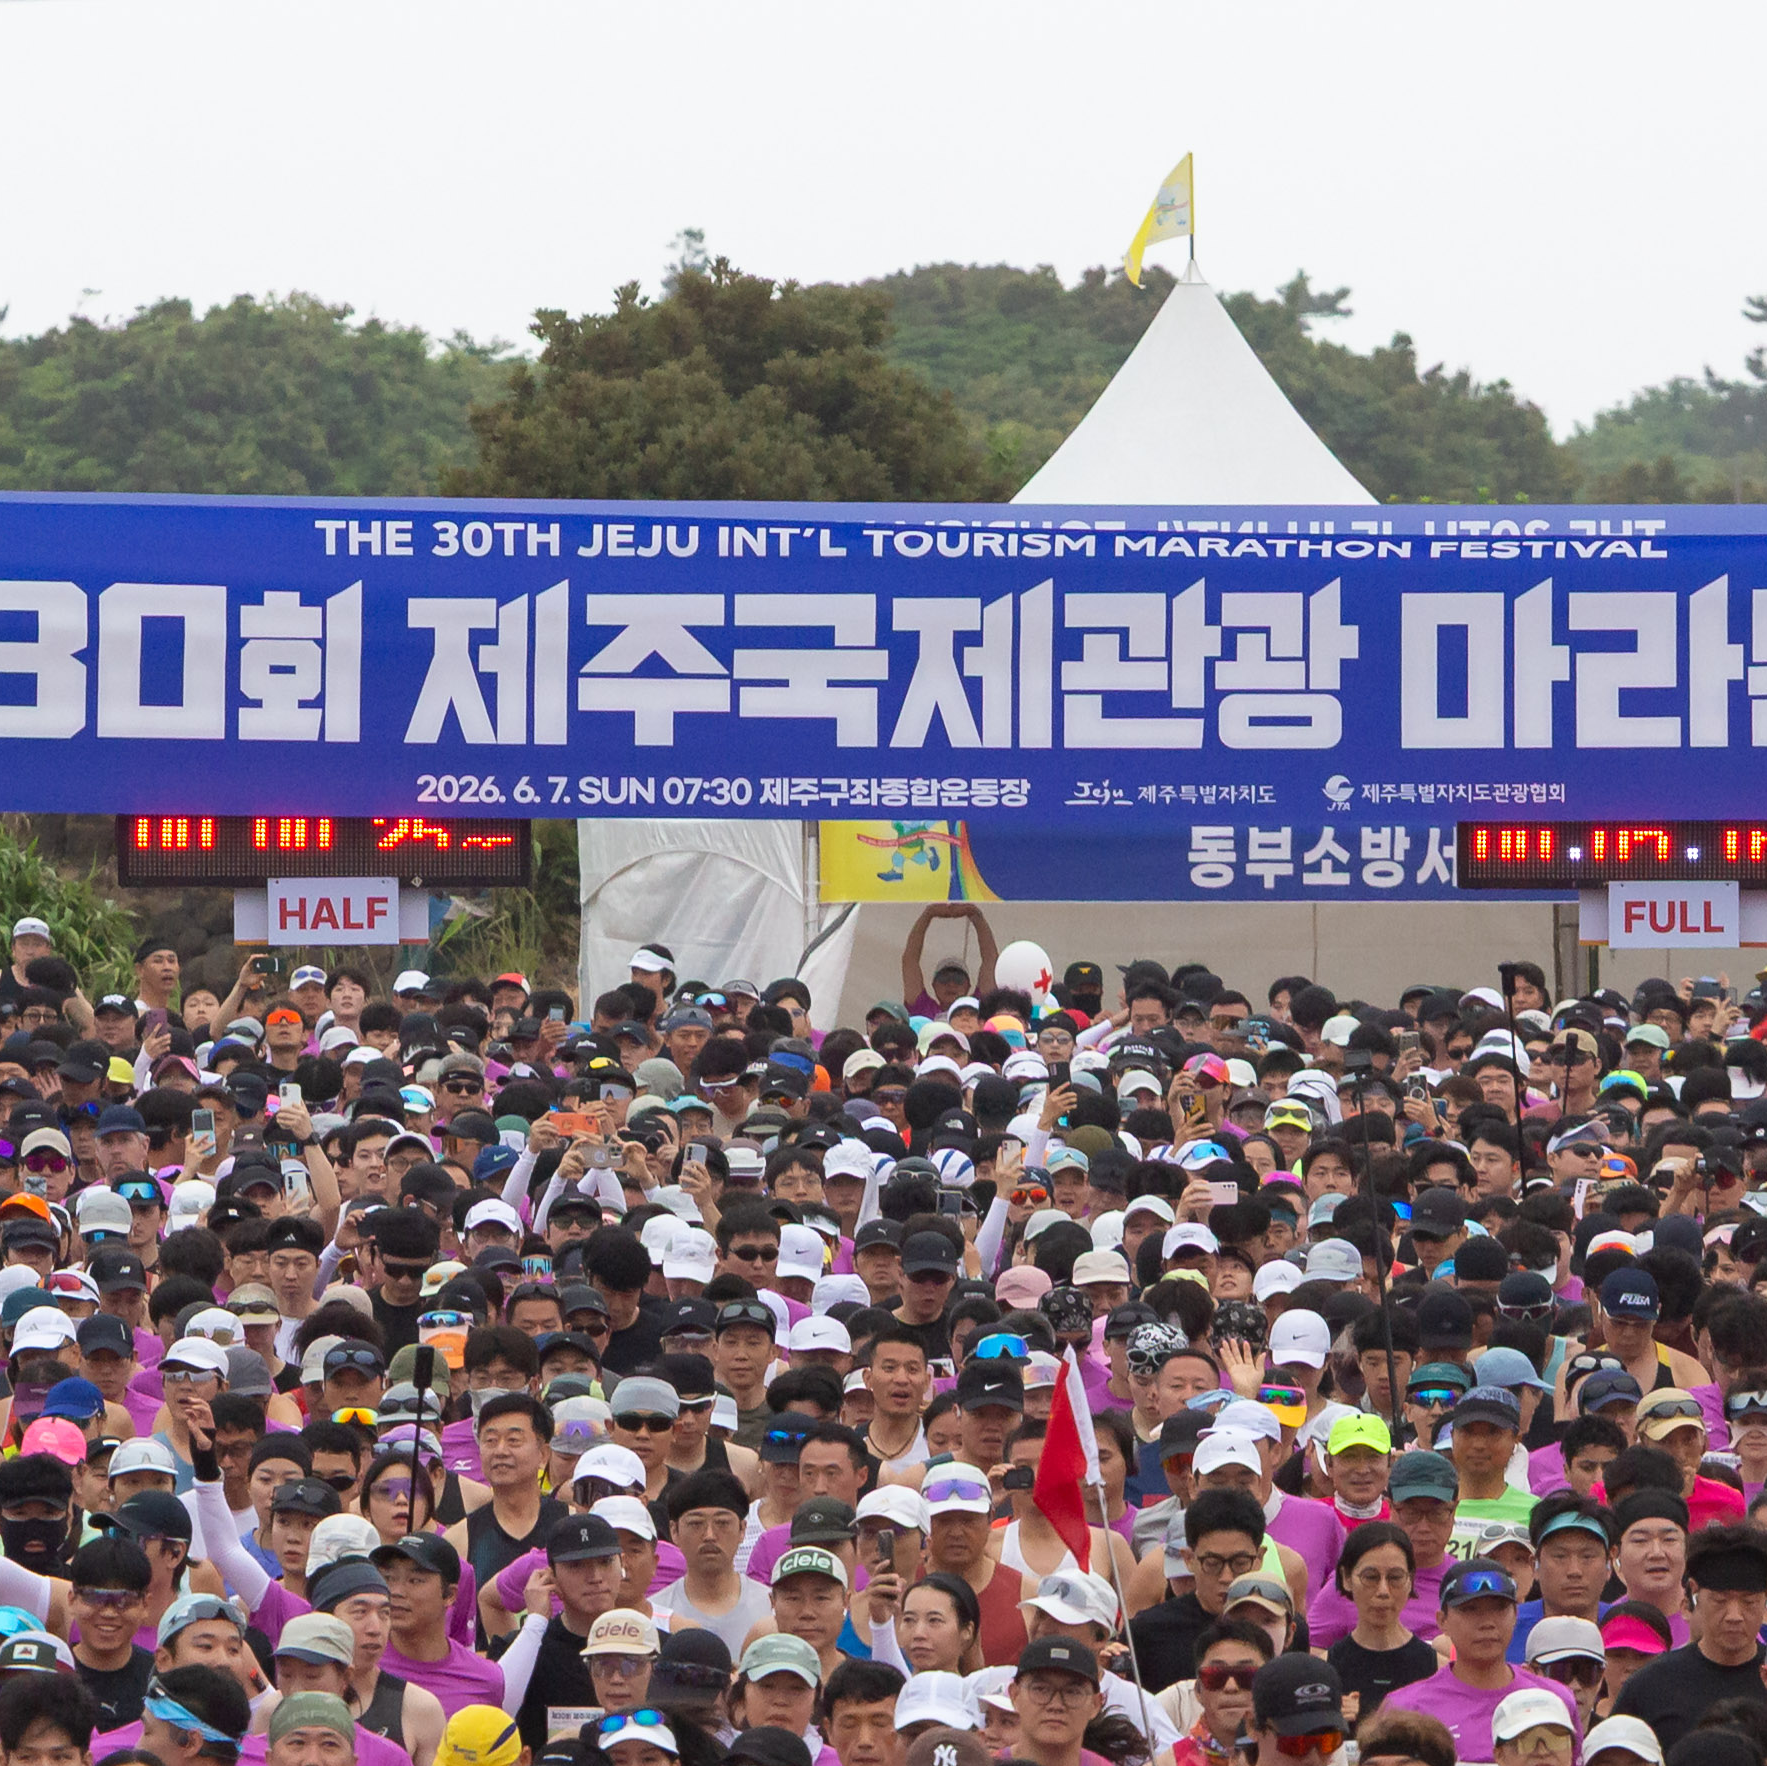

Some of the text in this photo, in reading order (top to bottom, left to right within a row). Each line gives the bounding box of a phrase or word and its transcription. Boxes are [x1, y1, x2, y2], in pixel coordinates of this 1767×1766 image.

[315, 521, 413, 556] THE
[432, 521, 561, 556] 30TH
[578, 524, 701, 558] JEJU
[863, 530, 1095, 558] TOURISM
[1115, 534, 1412, 559] MARATHON
[1431, 539, 1668, 559] FESTIVAL
[403, 577, 1359, 748] 제주국제관광
[416, 774, 1030, 807] 2026. 6. 7. SUN 07:30 제주구좌종합운동장
[1137, 782, 1276, 806] 제주특별자치도
[1361, 781, 1565, 805] 제주특별자치도관광협회
[277, 894, 390, 932] HALF
[1623, 900, 1724, 933] FULL
[781, 1552, 834, 1572] ciele
[595, 1621, 640, 1639] ciele
